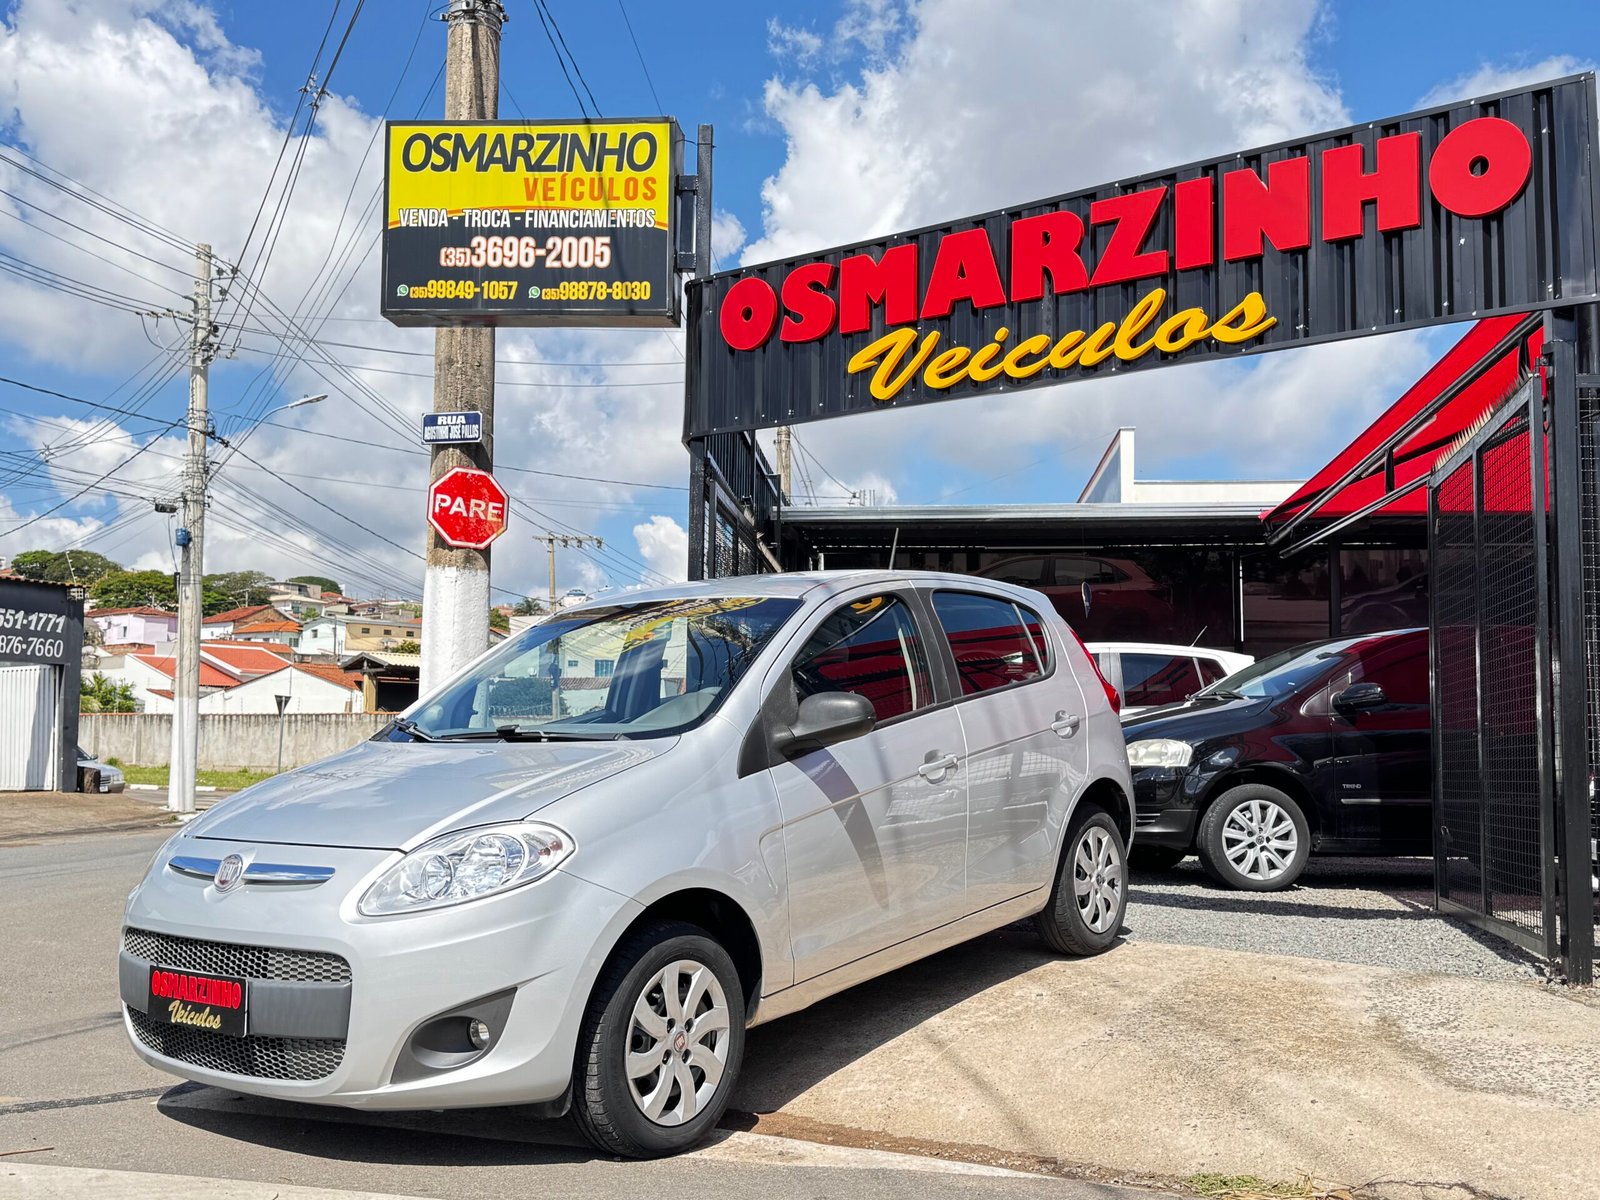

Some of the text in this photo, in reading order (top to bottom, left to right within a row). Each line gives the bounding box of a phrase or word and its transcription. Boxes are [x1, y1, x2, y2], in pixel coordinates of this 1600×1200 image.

[401, 132, 658, 173] OSMARZINHO
[524, 173, 657, 201] VEÍCULOS
[399, 208, 449, 228] VENDA
[463, 209, 510, 228] TROCA
[525, 208, 656, 228] FINANCIAMENTOS
[719, 116, 1533, 352] OSMARZINHO
[437, 415, 466, 425] RUA
[434, 493, 503, 522] PARE
[151, 970, 242, 1010] OSMARZINHO
